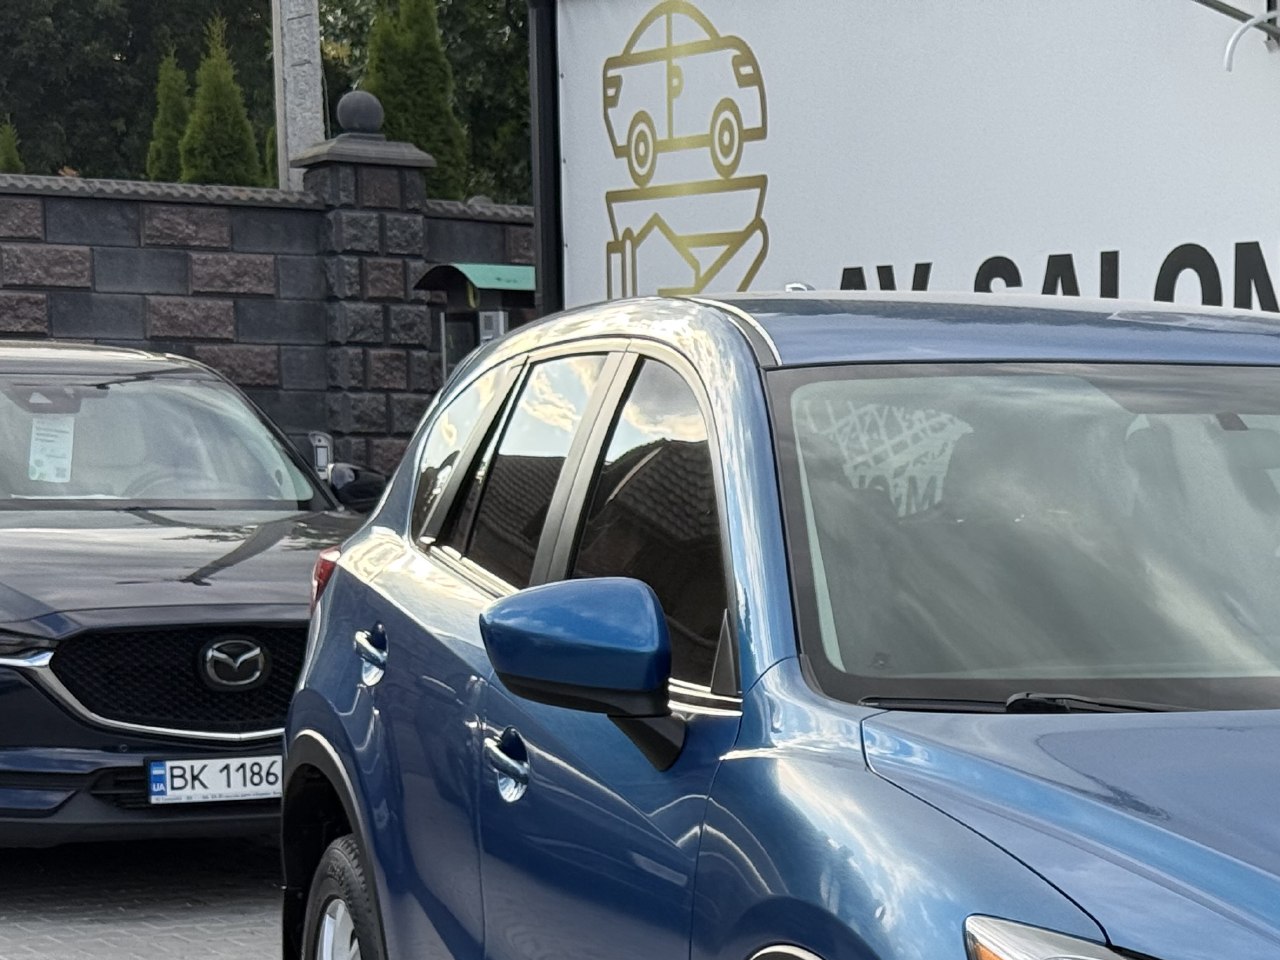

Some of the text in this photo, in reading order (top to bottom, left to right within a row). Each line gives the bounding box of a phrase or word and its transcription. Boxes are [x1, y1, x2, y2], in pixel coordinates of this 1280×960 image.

[169, 760, 280, 790] BK 1186
[152, 783, 166, 792] UA
